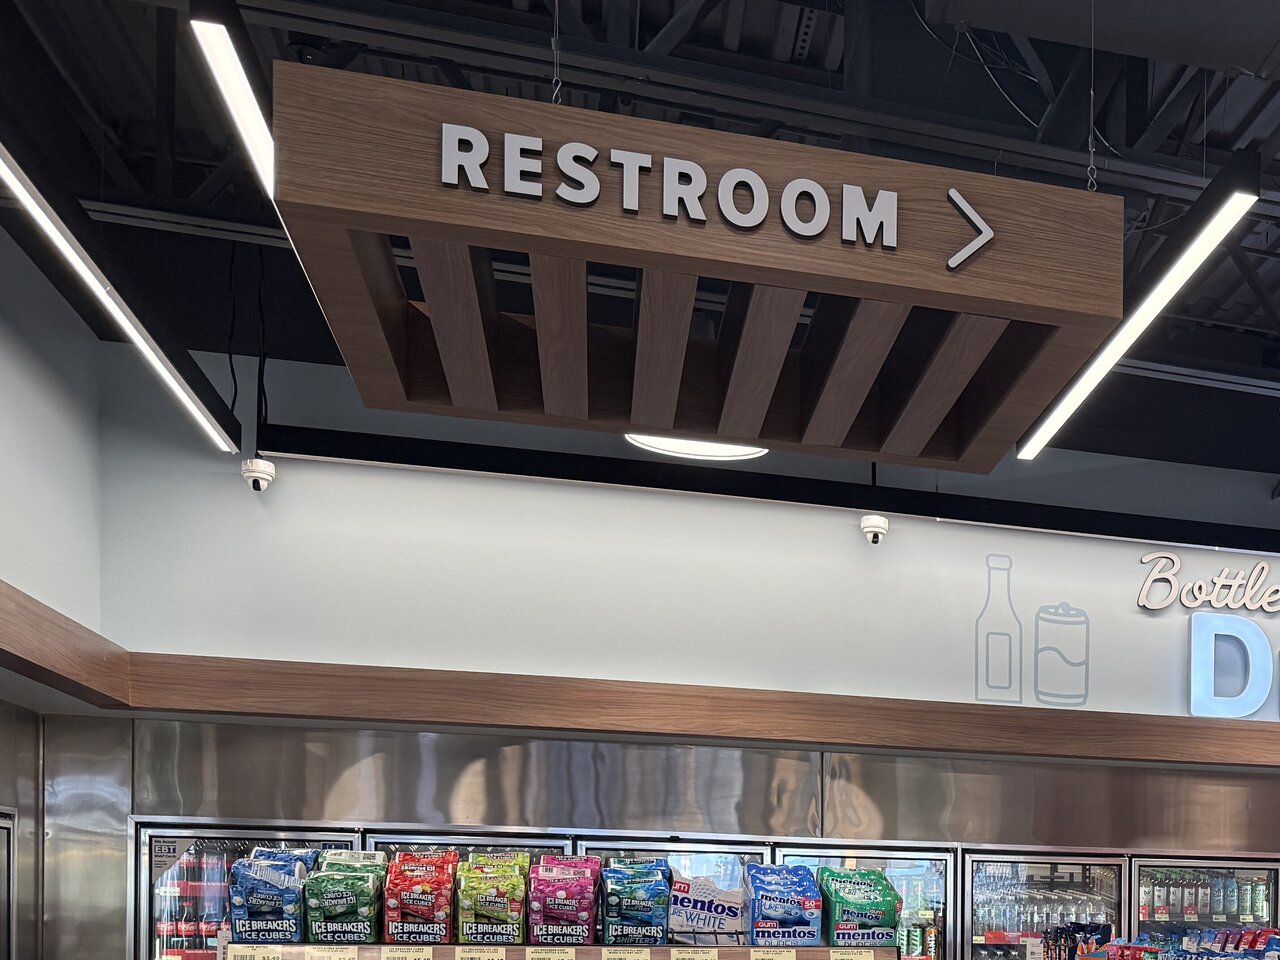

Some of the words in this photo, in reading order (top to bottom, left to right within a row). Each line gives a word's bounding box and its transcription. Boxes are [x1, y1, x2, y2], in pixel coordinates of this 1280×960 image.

[440, 122, 898, 249] RESTROOM
[155, 845, 175, 853] EBT
[235, 919, 250, 933] ICE
[253, 920, 295, 936] BREAKERS
[312, 921, 327, 934] ICE
[328, 922, 370, 934] BREAKERS
[685, 912, 725, 930] WHITE
[388, 922, 402, 934] ICE
[404, 922, 445, 935] BREAKERS
[463, 922, 476, 934] ICE
[478, 922, 518, 934] BREAKERS
[534, 925, 547, 936] ICE
[549, 925, 588, 938] BREAKERS
[755, 928, 816, 940] mentos
[836, 930, 894, 941] mentos
